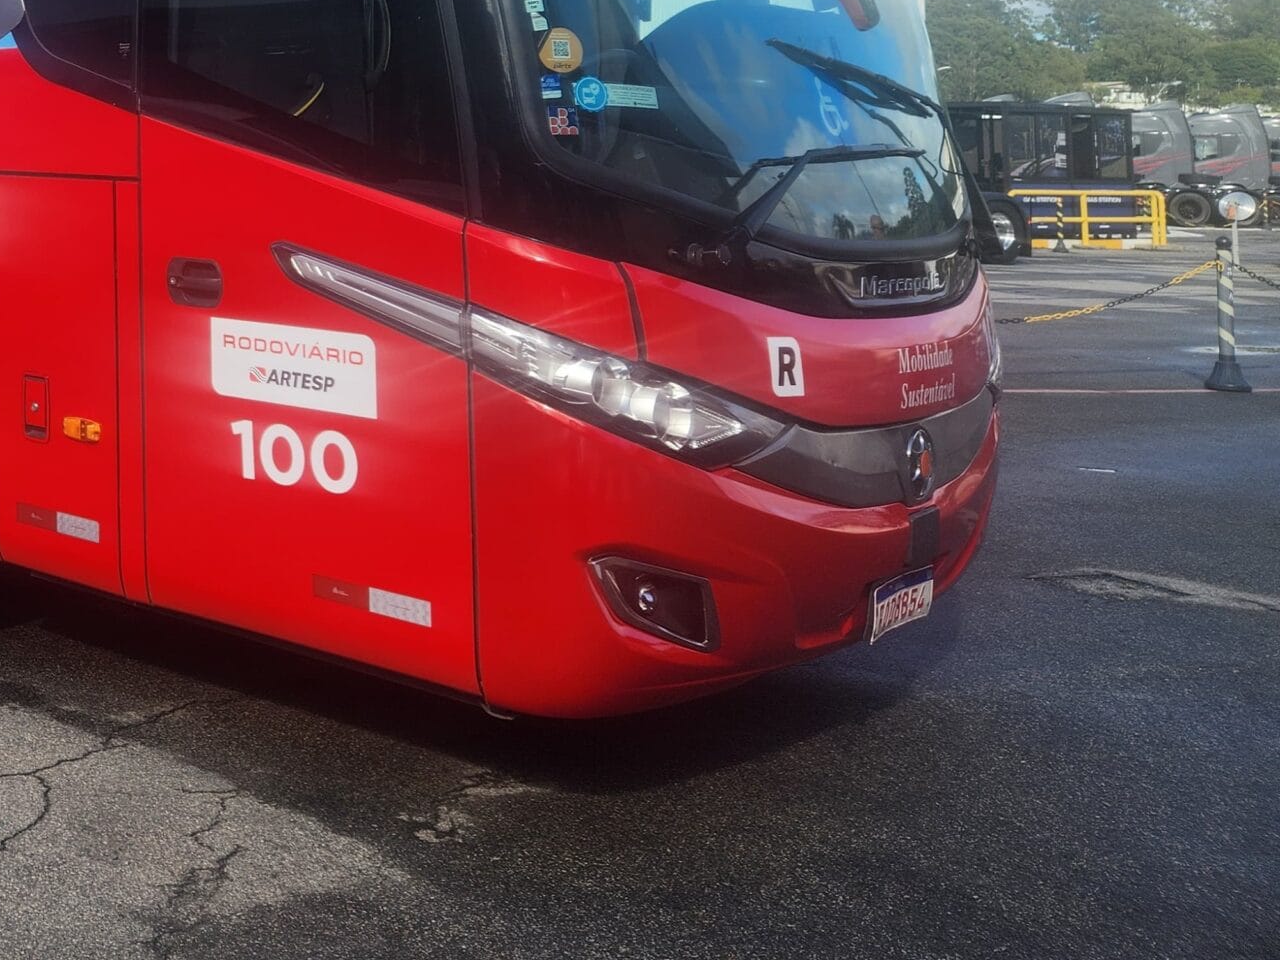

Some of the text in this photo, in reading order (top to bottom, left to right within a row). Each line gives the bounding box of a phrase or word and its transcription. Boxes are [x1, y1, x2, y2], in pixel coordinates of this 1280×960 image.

[223, 333, 364, 366] RODOVIÁRIO
[777, 347, 798, 386] R
[897, 340, 953, 374] Mobilidade
[266, 366, 335, 393] ARTESP
[900, 372, 955, 409] Sustentável
[230, 419, 359, 495] 100
